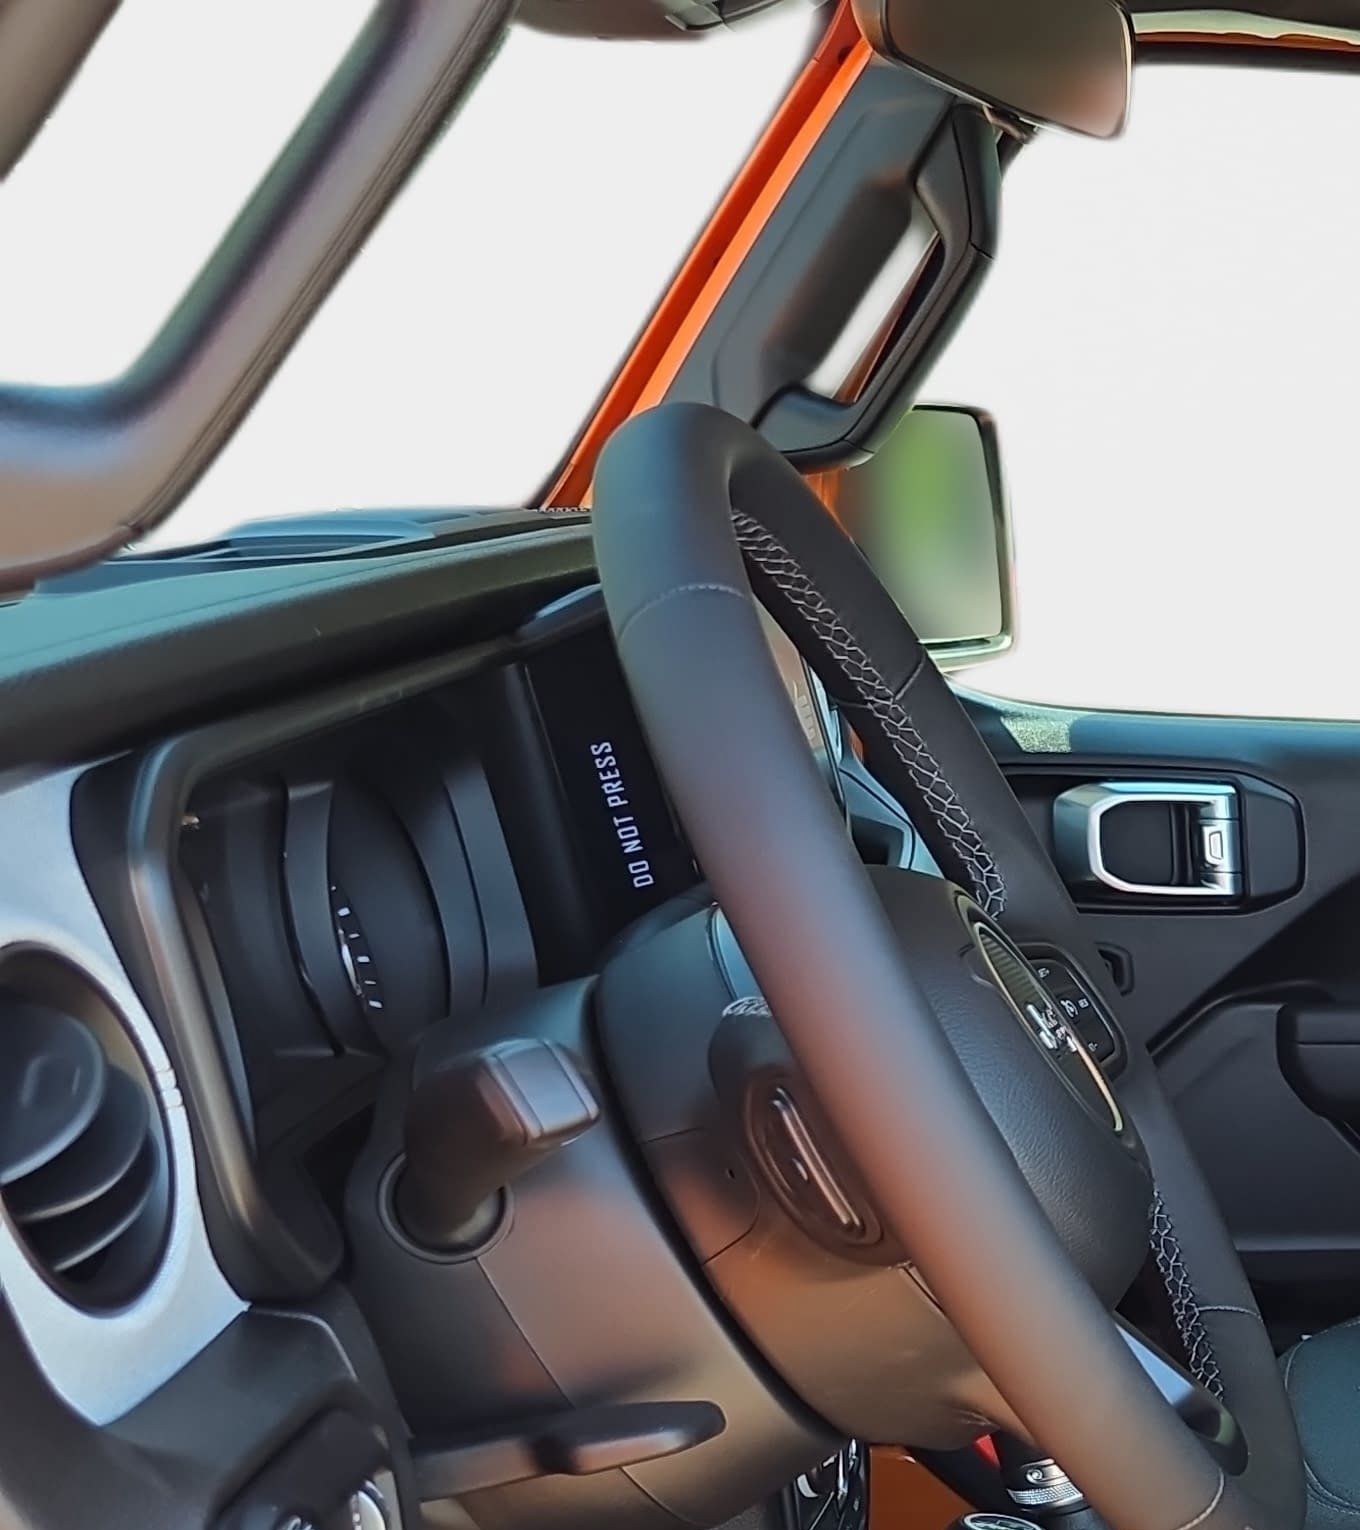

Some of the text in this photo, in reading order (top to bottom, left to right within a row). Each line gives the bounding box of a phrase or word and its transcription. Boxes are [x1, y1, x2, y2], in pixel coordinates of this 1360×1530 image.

[590, 741, 654, 888] DO NOT PRESS
